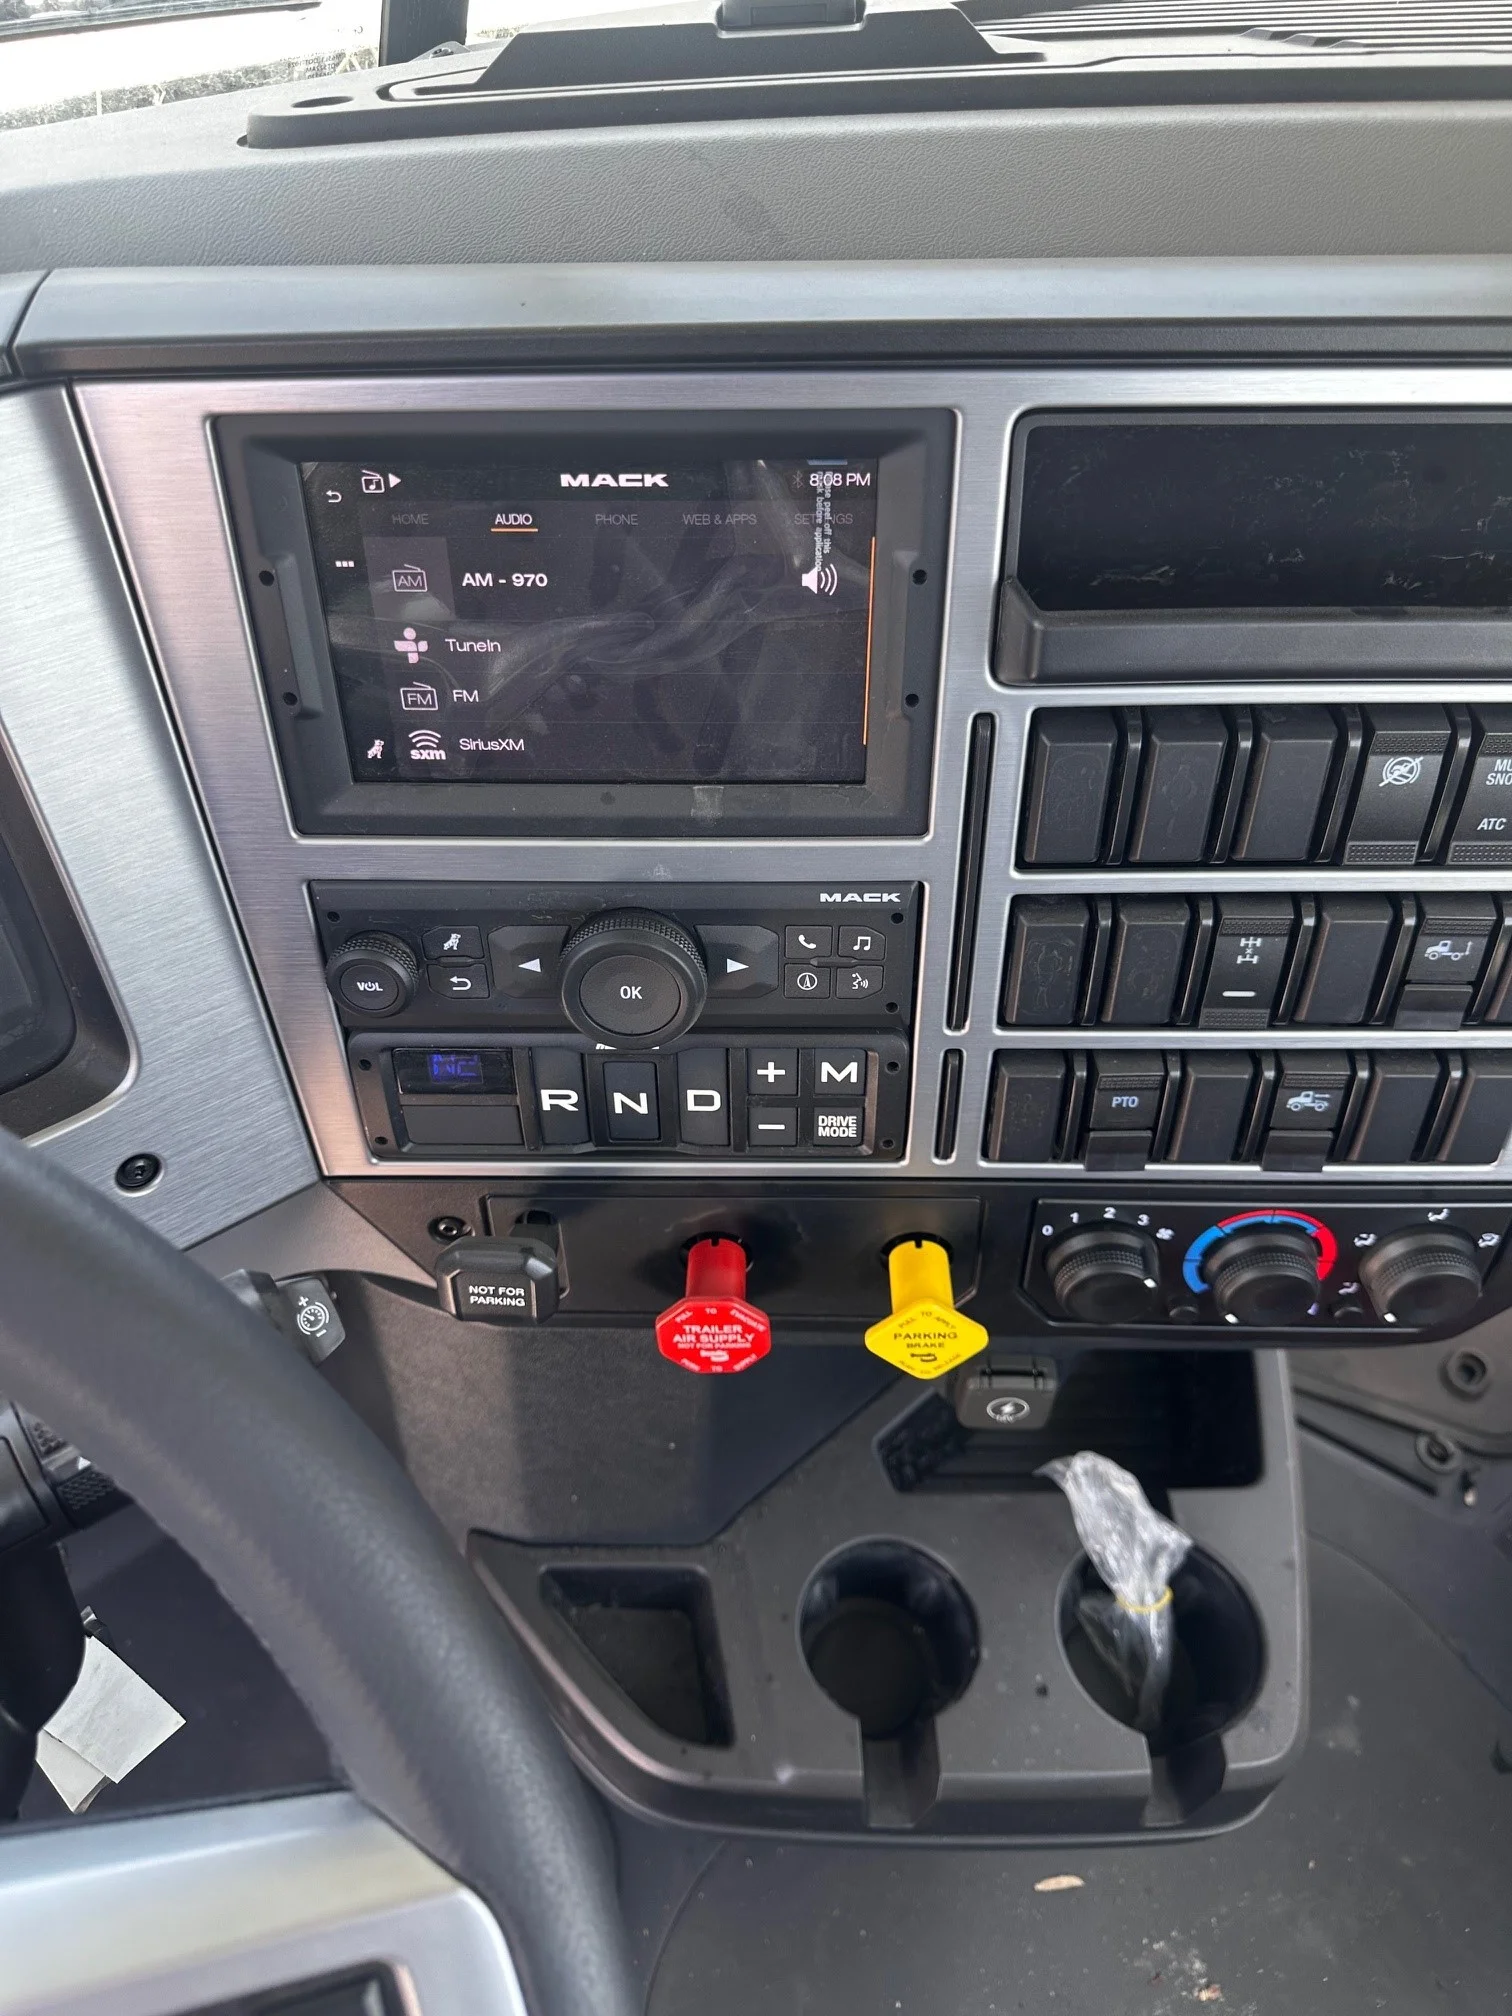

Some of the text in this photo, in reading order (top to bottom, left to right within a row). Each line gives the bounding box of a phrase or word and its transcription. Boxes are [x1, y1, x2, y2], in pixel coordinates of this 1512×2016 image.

[560, 473, 669, 487] MACK
[810, 473, 870, 486] 8:08 PM
[816, 496, 824, 524] before
[392, 513, 429, 525] HOME
[494, 513, 532, 525] AUDIO
[595, 513, 639, 526] PHONE
[682, 514, 757, 525] WEB & APPS
[824, 522, 832, 535] off
[823, 538, 832, 554] this
[398, 575, 423, 587] AM
[462, 572, 493, 587] AM
[512, 573, 548, 587] 970
[444, 638, 502, 652] TuneIn
[407, 693, 432, 705] FM
[452, 689, 479, 702] FM
[459, 738, 525, 751] SiriusXM
[410, 750, 446, 760] sxm
[1476, 818, 1507, 830] ATC
[820, 892, 901, 902] MACK
[620, 985, 643, 1000] OK
[820, 1061, 858, 1083] M
[540, 1089, 579, 1112] R
[613, 1092, 649, 1114] N
[686, 1089, 721, 1112] D
[1112, 1096, 1138, 1108] PTO
[818, 1116, 857, 1126] DRIVE
[818, 1126, 857, 1138] MODE
[1070, 1212, 1080, 1224] 1
[1103, 1206, 1116, 1219] 2
[1137, 1214, 1150, 1226] 3
[1042, 1224, 1054, 1236] 0
[468, 1286, 524, 1296] NOT FOR
[470, 1296, 526, 1307] PARKING
[920, 1310, 932, 1318] TO
[682, 1324, 743, 1334] TRAILER
[672, 1333, 755, 1343] AIR SUPPLY
[894, 1332, 958, 1340] PARKING
